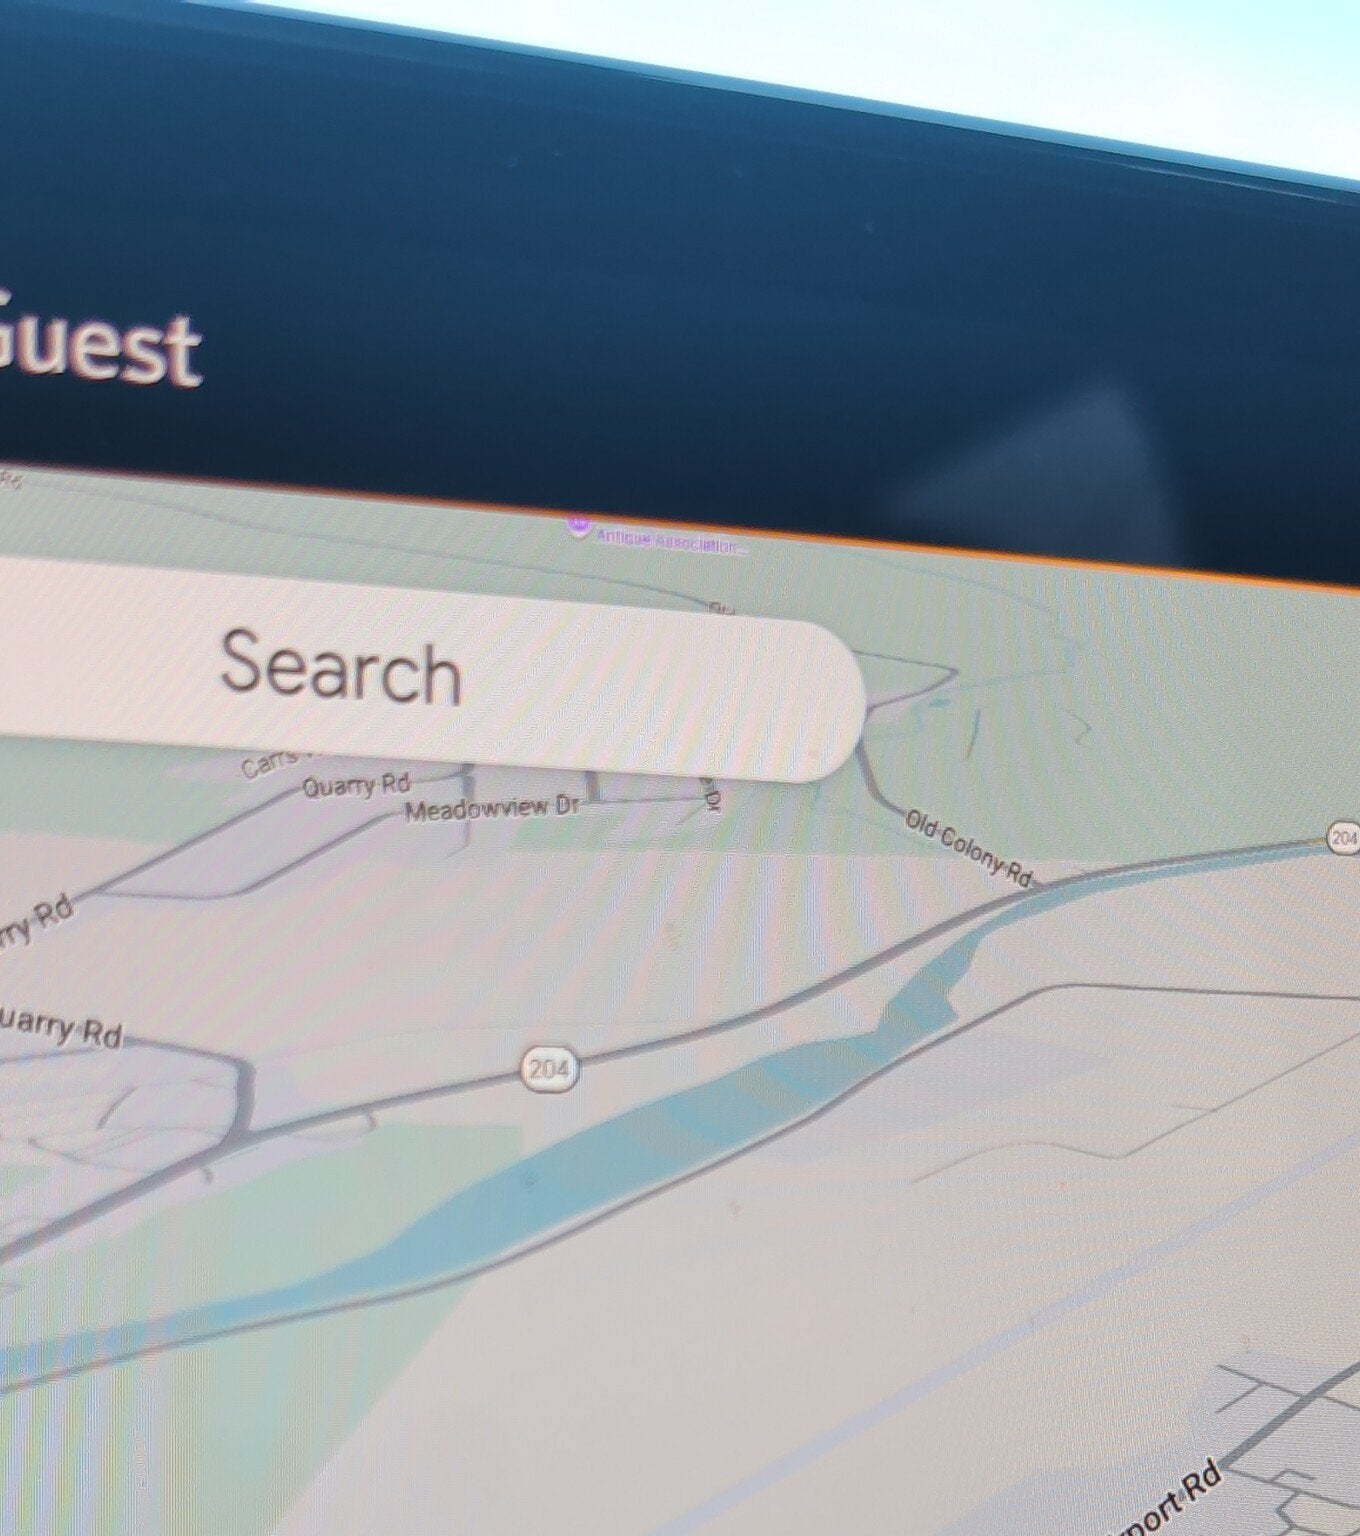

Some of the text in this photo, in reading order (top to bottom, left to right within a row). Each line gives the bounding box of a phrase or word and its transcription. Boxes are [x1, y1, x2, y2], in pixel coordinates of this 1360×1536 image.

[221, 627, 462, 707] Search
[302, 772, 411, 799] Quarry Rd
[404, 794, 581, 822] Meadowview Dr
[906, 809, 1034, 888] Old Colony Rd
[1332, 829, 1359, 847] 204
[34, 892, 75, 928] Rd
[83, 1019, 122, 1049] Rd
[529, 1058, 571, 1081] 204
[1181, 1457, 1222, 1501] Rd
